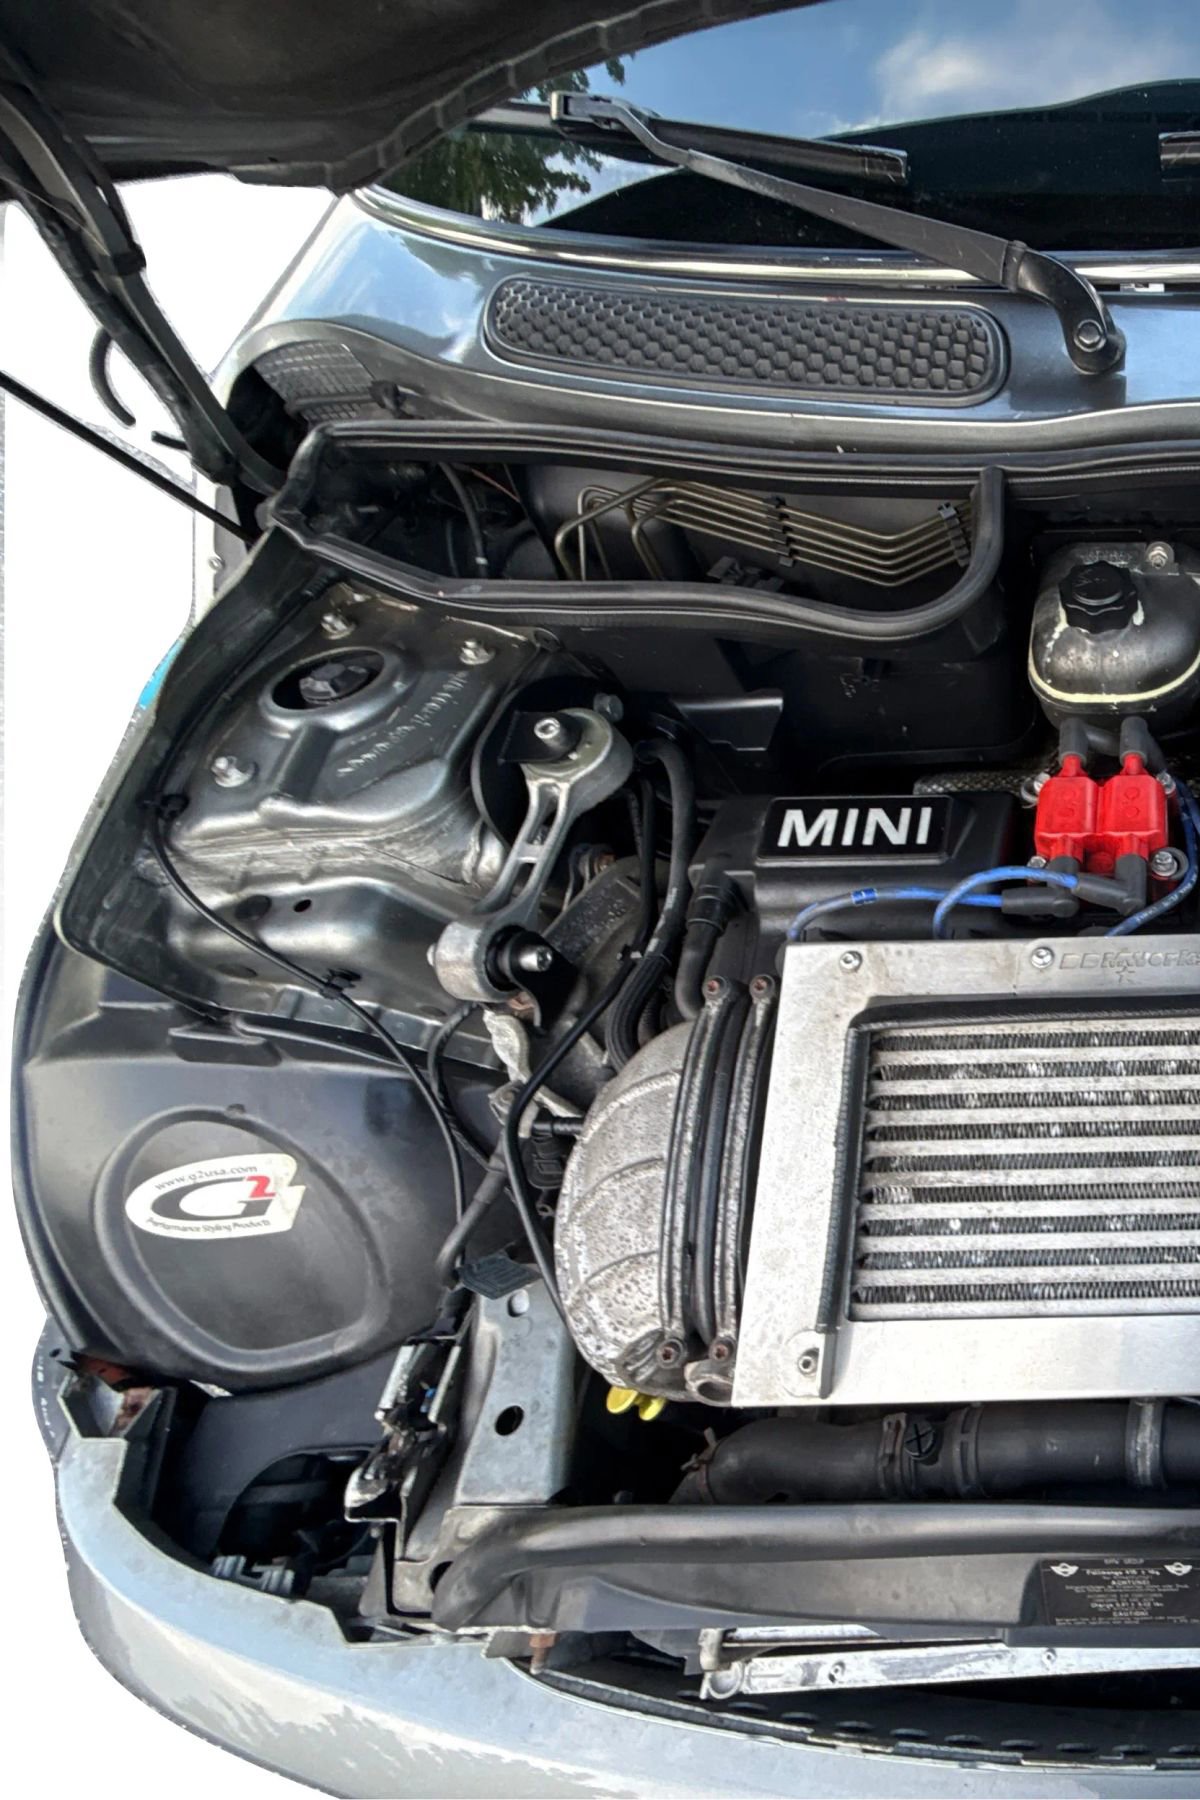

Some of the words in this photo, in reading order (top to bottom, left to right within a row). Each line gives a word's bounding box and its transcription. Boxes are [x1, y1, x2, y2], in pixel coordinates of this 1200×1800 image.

[777, 807, 932, 848] MINI
[154, 1166, 257, 1190] www.g2usa.com
[147, 1217, 201, 1232] Performance
